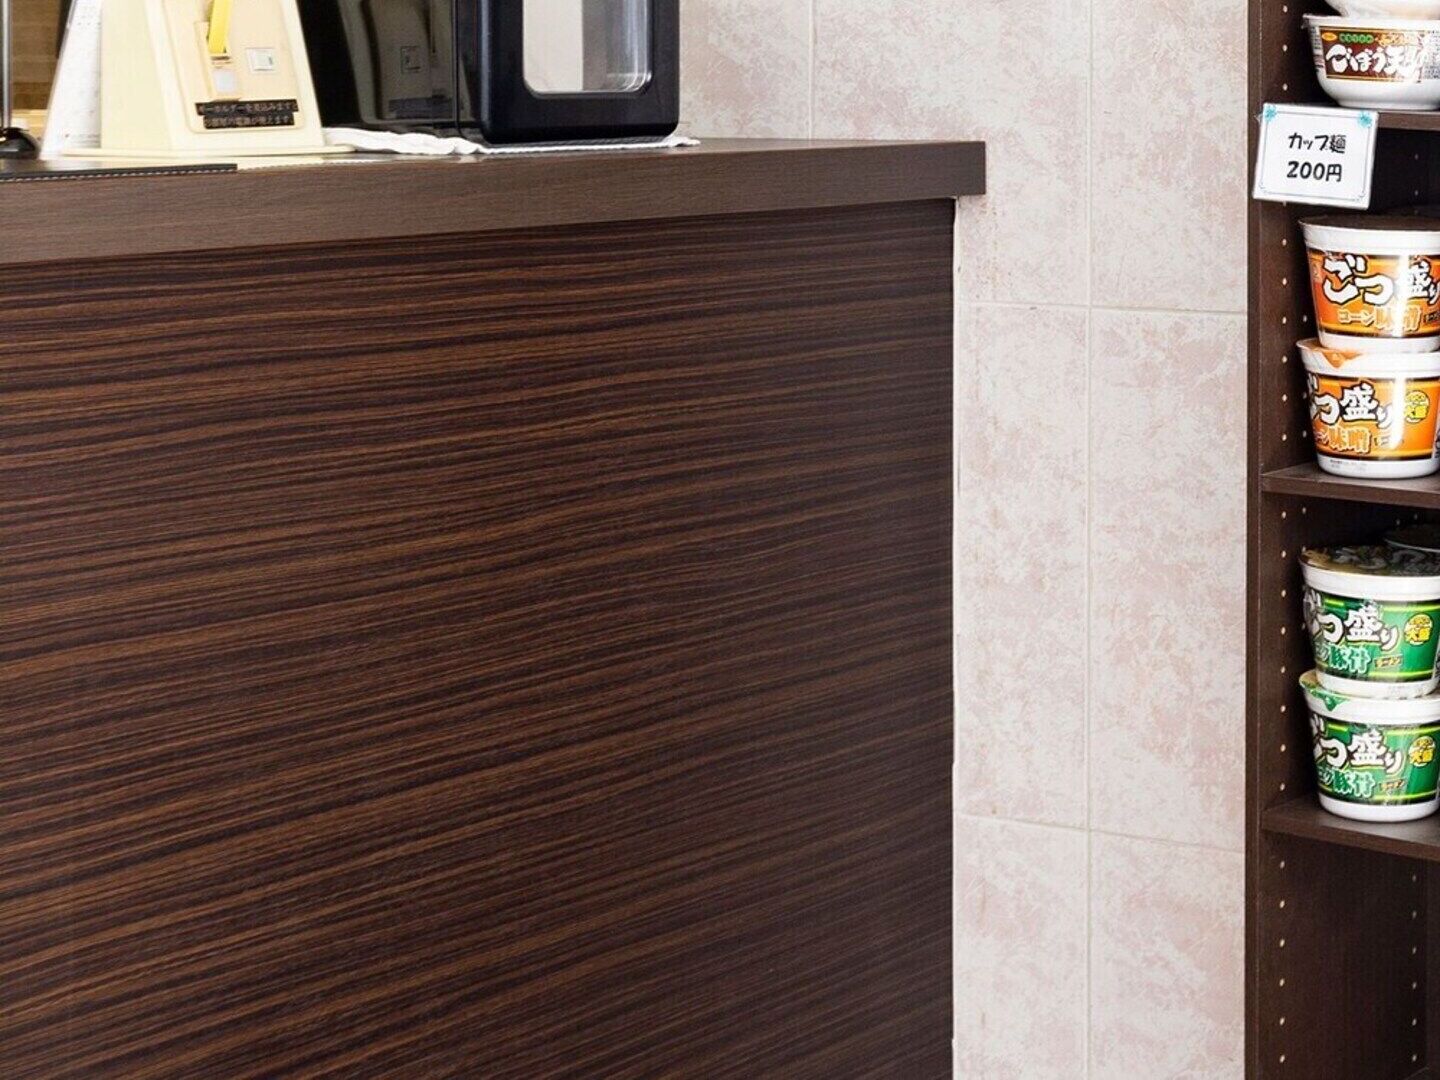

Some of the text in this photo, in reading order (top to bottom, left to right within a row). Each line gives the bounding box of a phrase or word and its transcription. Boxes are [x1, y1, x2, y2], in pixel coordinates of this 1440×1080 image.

[1288, 133, 1347, 154] カップ麺
[1287, 161, 1343, 182] 200円
